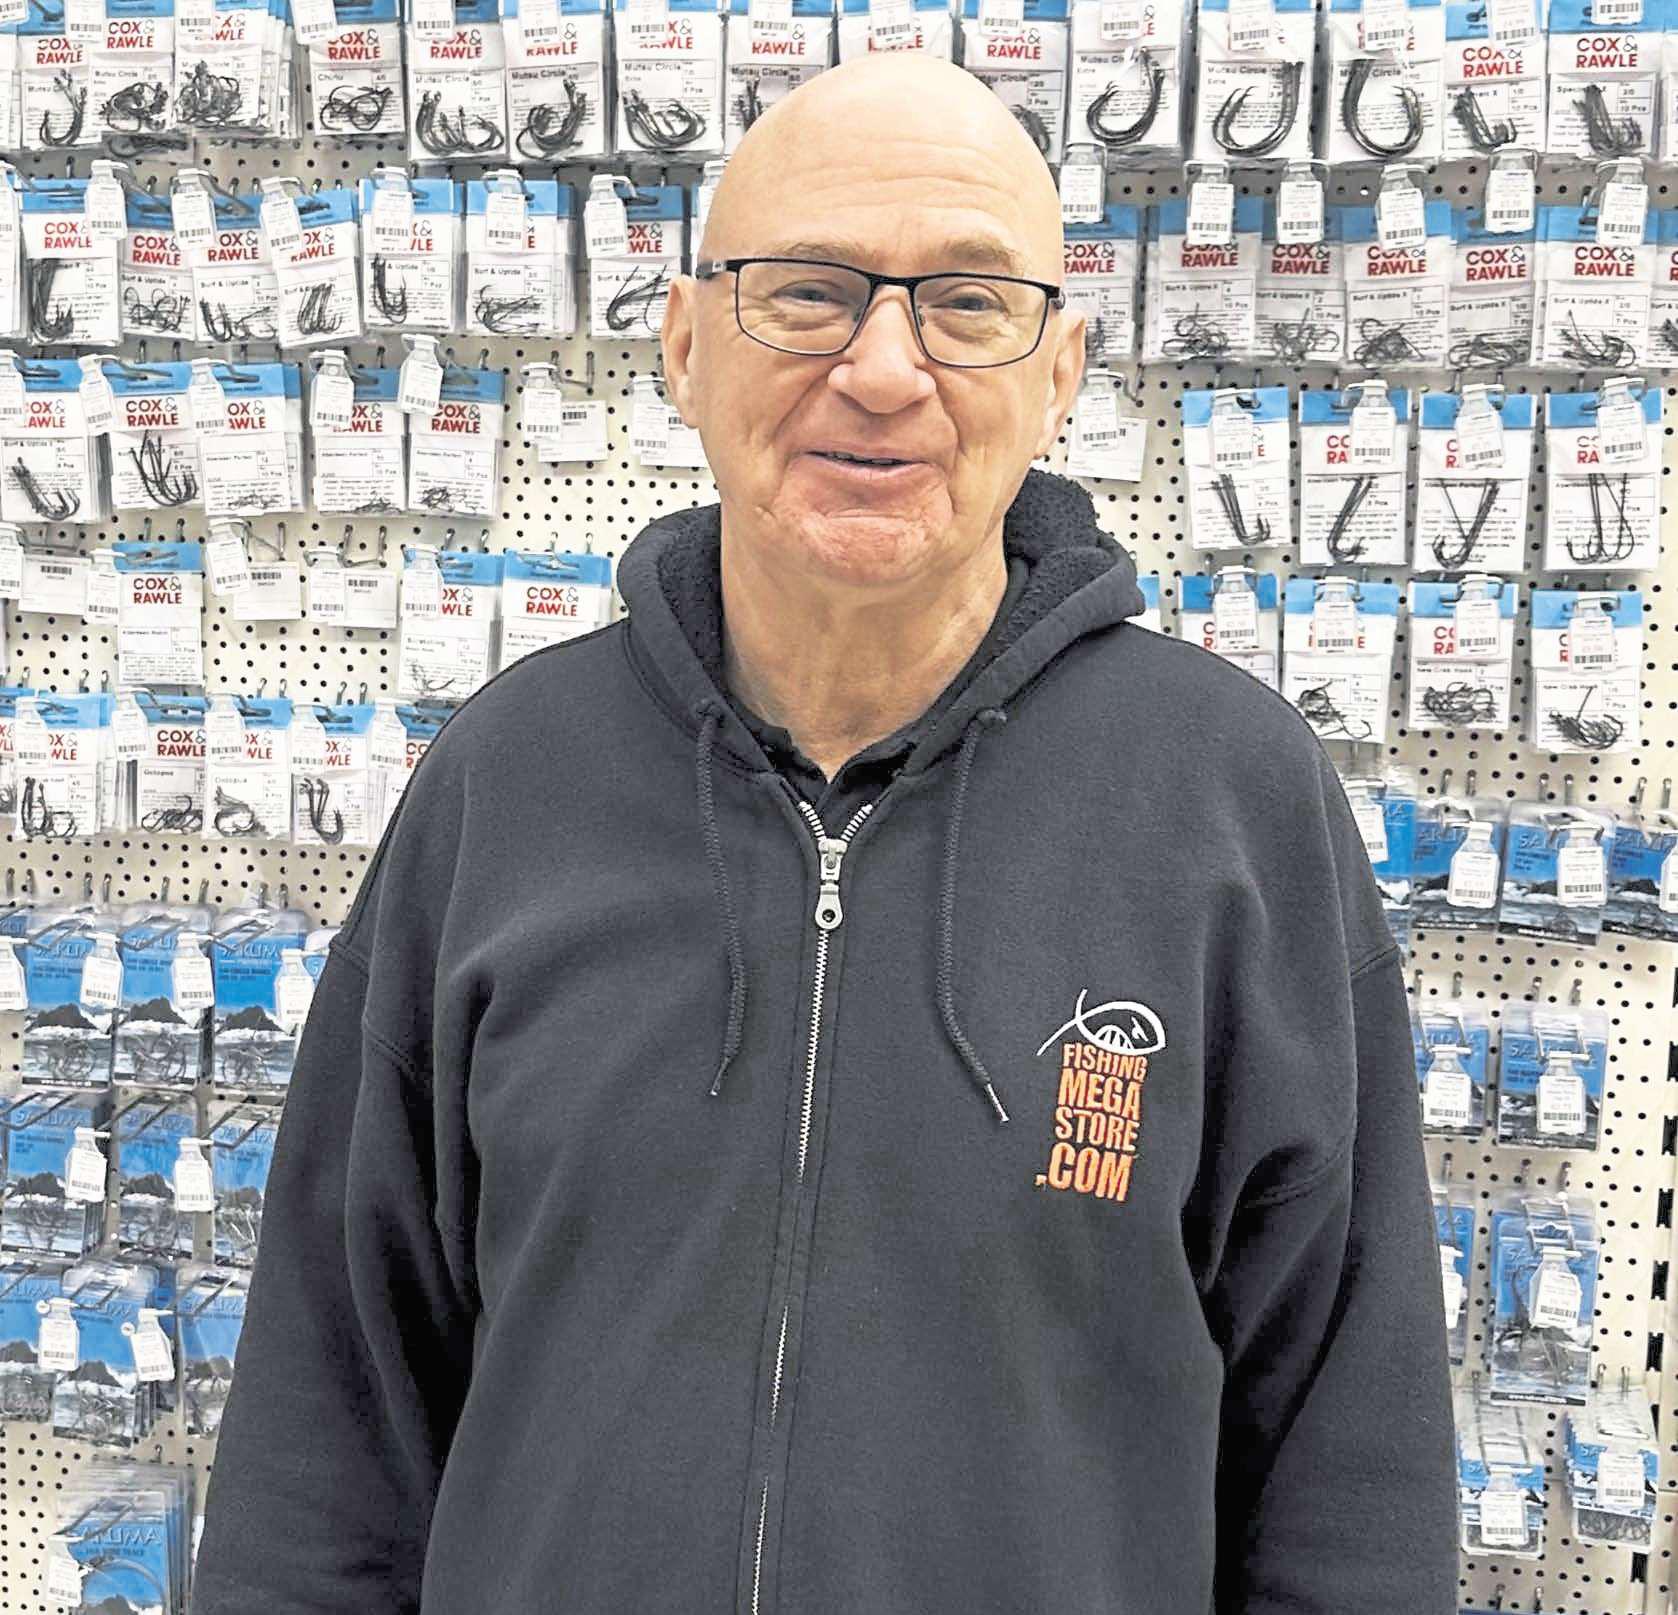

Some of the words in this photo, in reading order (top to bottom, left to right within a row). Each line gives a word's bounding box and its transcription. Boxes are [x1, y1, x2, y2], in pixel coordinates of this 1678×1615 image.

[108, 36, 153, 48] RAWLE
[752, 42, 805, 55] RAWLE
[37, 51, 83, 64] RAWLE
[328, 46, 380, 60] RAWLE
[430, 46, 482, 58] RAWLE
[987, 45, 1040, 60] RAWLE
[1576, 53, 1637, 67] RAWLE
[762, 68, 788, 76] Circle
[1464, 61, 1523, 77] RAWLE
[45, 236, 92, 248] RAWLE
[133, 250, 180, 265] RAWLE
[208, 247, 259, 262] RAWLE
[1182, 254, 1238, 267] RAWLE
[1272, 260, 1330, 274] RAWLE
[1368, 260, 1426, 276] RAWLE
[1467, 264, 1526, 281] RAWLE
[1574, 263, 1634, 276] RAWLE
[24, 416, 65, 428] AWLE
[127, 413, 179, 427] RAWLE
[432, 419, 480, 434] RAWLE
[134, 593, 182, 604] RAWLE
[442, 604, 472, 616] WLE
[526, 602, 577, 616] RAWLE
[157, 744, 206, 757] RAWLE
[1062, 1042, 1148, 1082] FISHING
[1057, 1067, 1144, 1121] MEGA
[1055, 1105, 1140, 1152] STORE
[1035, 1142, 1134, 1203] .COM
